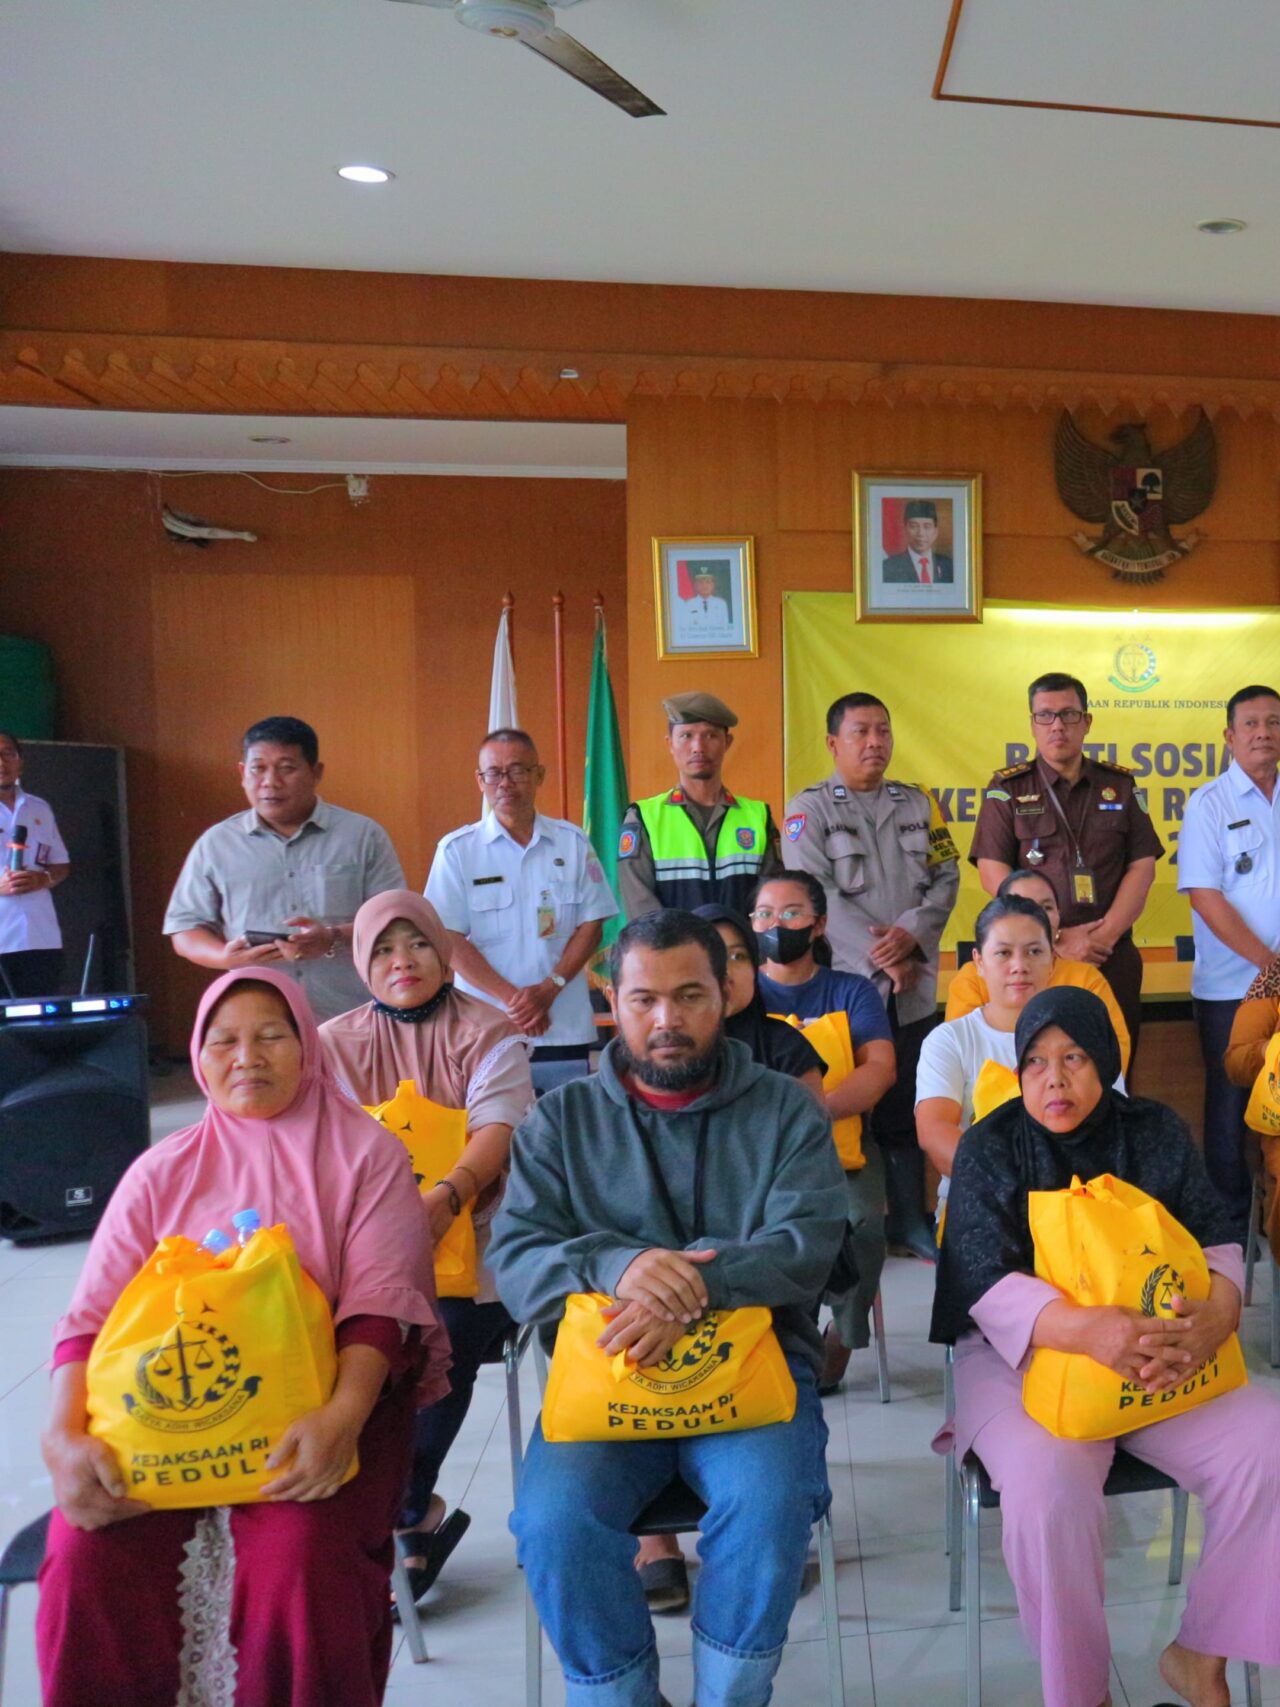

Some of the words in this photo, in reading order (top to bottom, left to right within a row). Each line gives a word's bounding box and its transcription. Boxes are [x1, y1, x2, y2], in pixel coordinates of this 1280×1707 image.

[1114, 699, 1169, 709] REPUBLIK
[1006, 743, 1117, 767] BTI
[1119, 1363, 1218, 1410] PEDULI
[608, 1402, 713, 1416] KEJAKSAAN
[608, 1406, 738, 1430] PEDULI
[132, 1442, 243, 1467] KEJAKSAAN
[250, 1436, 270, 1451] RI
[132, 1453, 270, 1485] PEDUL
